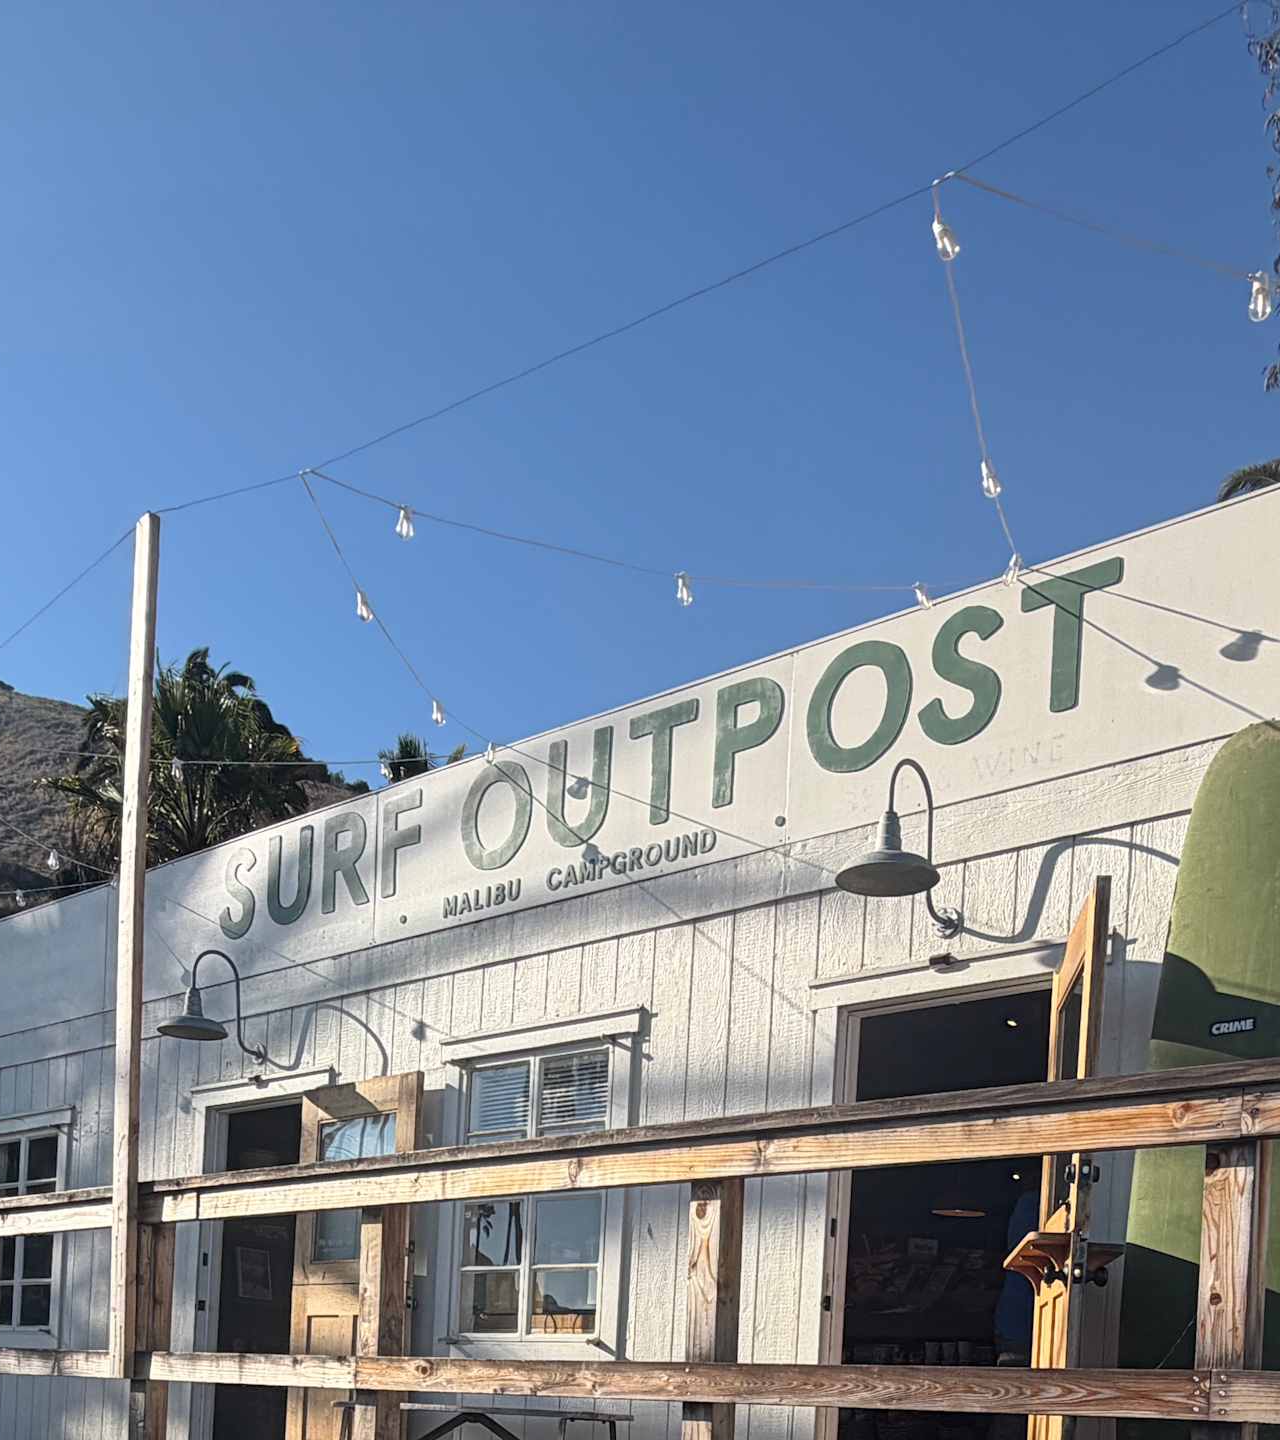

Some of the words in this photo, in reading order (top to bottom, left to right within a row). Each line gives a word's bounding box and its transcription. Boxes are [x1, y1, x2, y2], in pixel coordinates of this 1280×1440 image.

[219, 787, 423, 940] SURF
[461, 556, 1125, 870] OUTPOST
[442, 878, 522, 919] MALIBU
[546, 829, 717, 891] CAMPGROUND
[1211, 1018, 1255, 1035] CRIME
